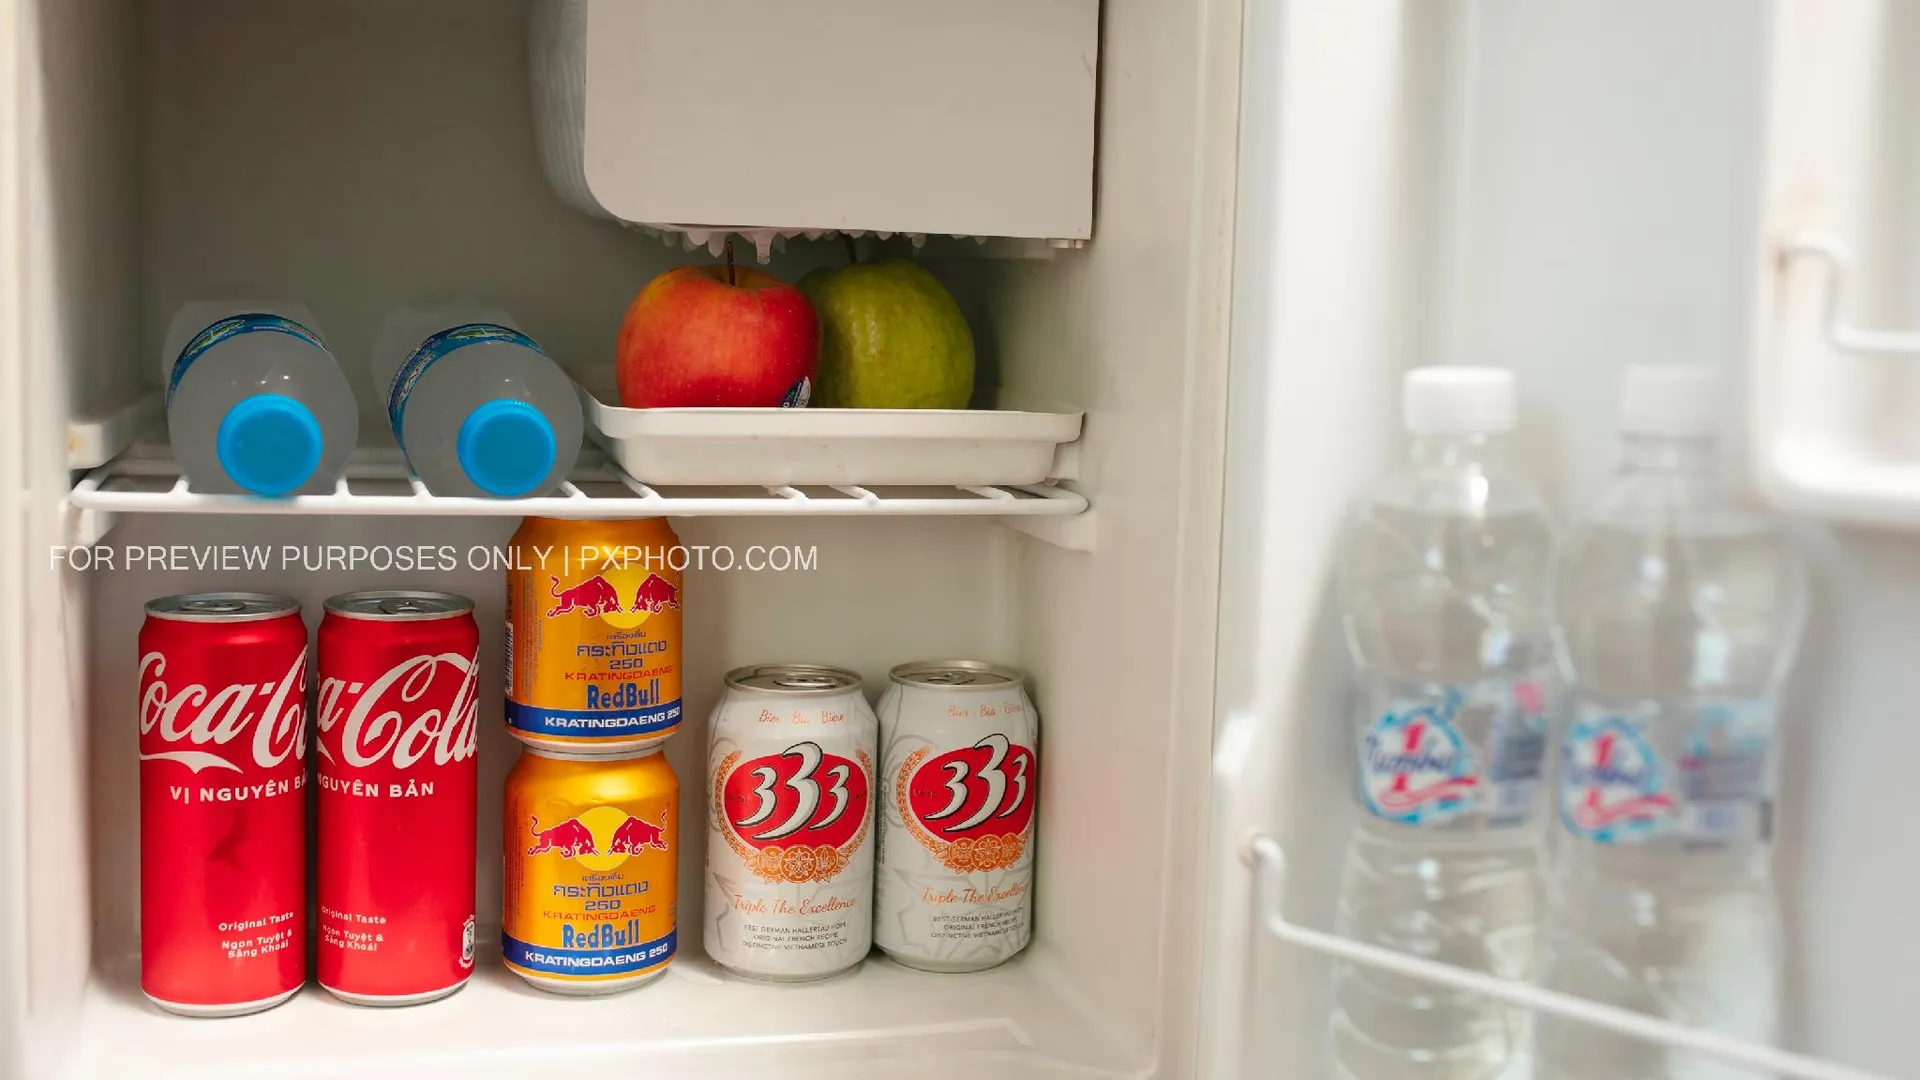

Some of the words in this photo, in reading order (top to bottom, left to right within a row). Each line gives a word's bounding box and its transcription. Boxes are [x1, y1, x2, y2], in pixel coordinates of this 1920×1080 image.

[565, 664, 673, 681] KRATINGDAENG
[609, 658, 643, 670] 250
[545, 711, 666, 728] KRATINGDAENG
[667, 705, 681, 720] 250
[170, 785, 190, 805] VỊ
[199, 779, 289, 803] NGUYÊN
[389, 779, 434, 798] BẢN
[734, 740, 851, 842] 333
[923, 733, 1028, 833] 333
[585, 899, 621, 911] 250
[734, 894, 767, 915] Triple
[771, 898, 796, 915] The
[799, 896, 856, 917] Excellence
[962, 887, 985, 904] The
[218, 917, 267, 932] Original
[269, 911, 294, 924] Taste
[321, 905, 352, 922] Original
[355, 914, 387, 925] Taste
[543, 904, 656, 921] KRATINGDAENG
[221, 939, 253, 950] Ngon
[525, 950, 647, 968] KRATINGDAENG
[648, 942, 668, 958] 250
